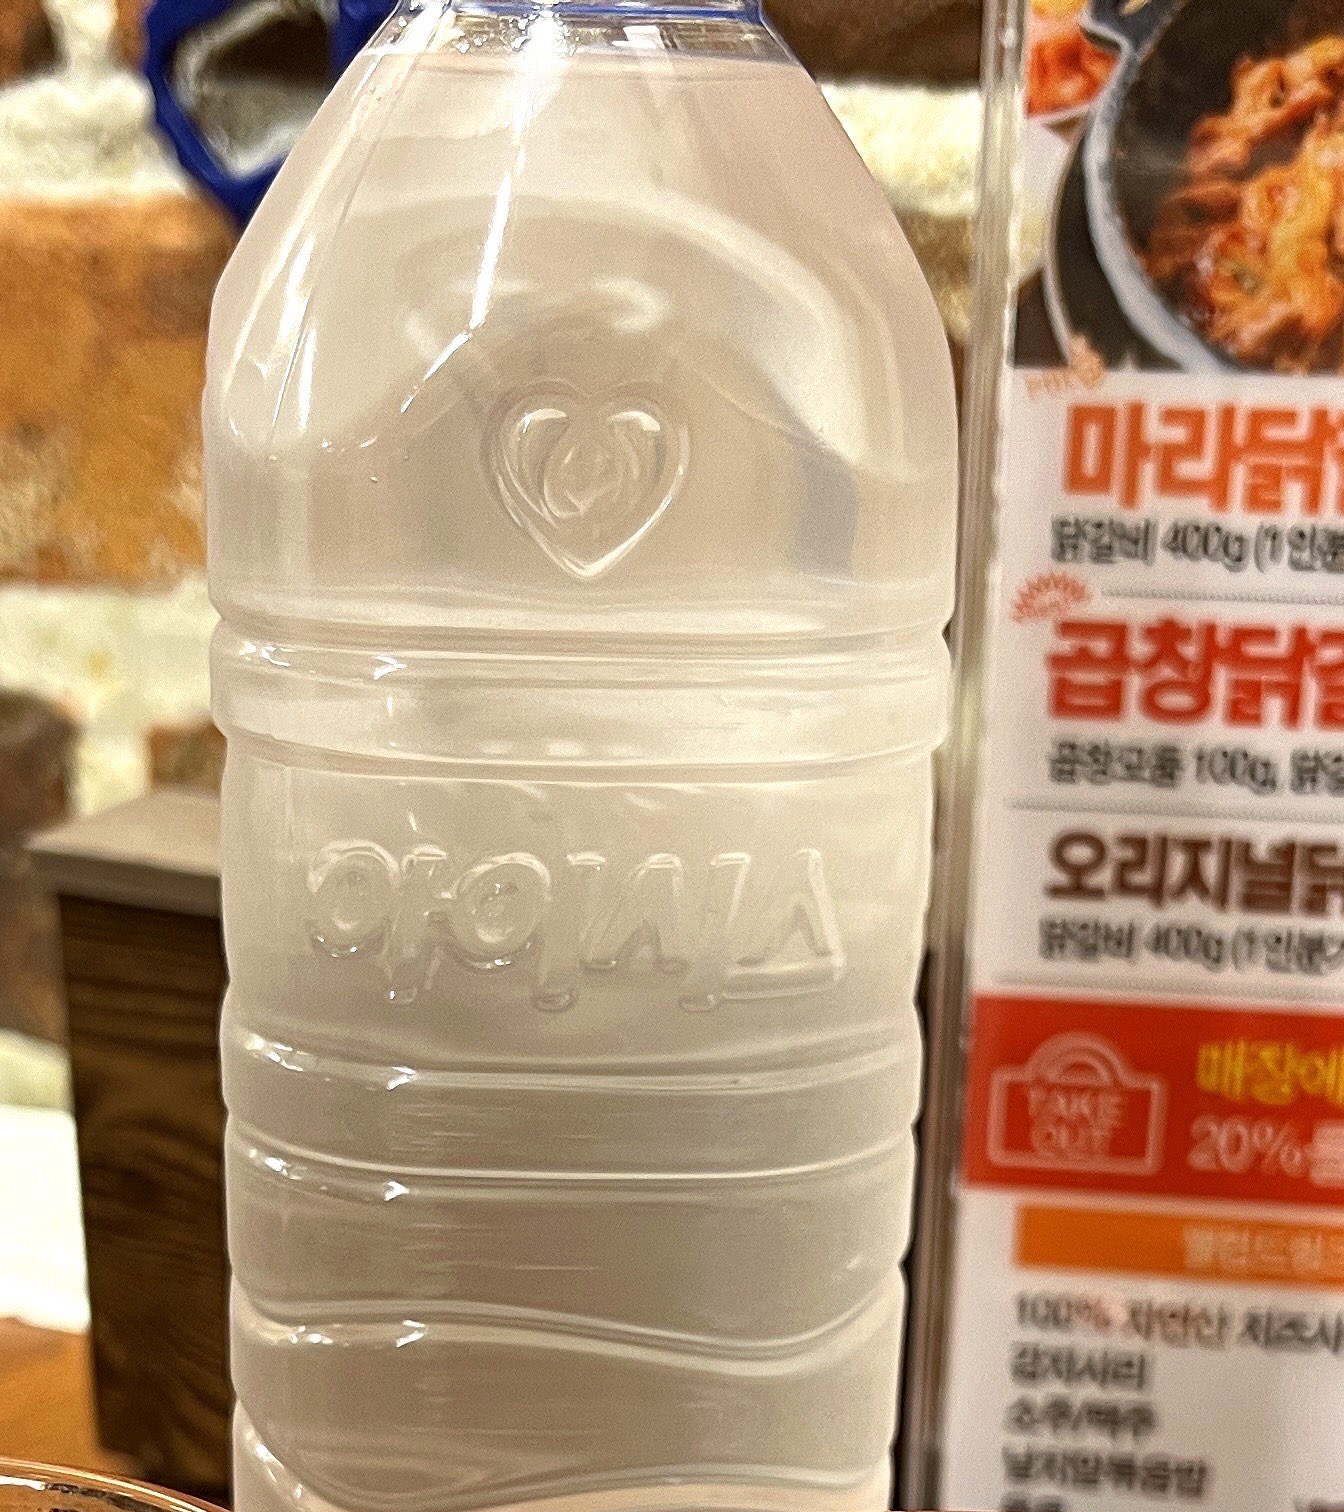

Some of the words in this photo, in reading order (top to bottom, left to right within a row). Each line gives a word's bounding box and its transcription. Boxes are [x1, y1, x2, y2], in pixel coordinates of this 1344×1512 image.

[1052, 516, 1154, 565] 닭갈비
[1161, 521, 1250, 572] 400g
[1039, 918, 1135, 964] 닭갈비
